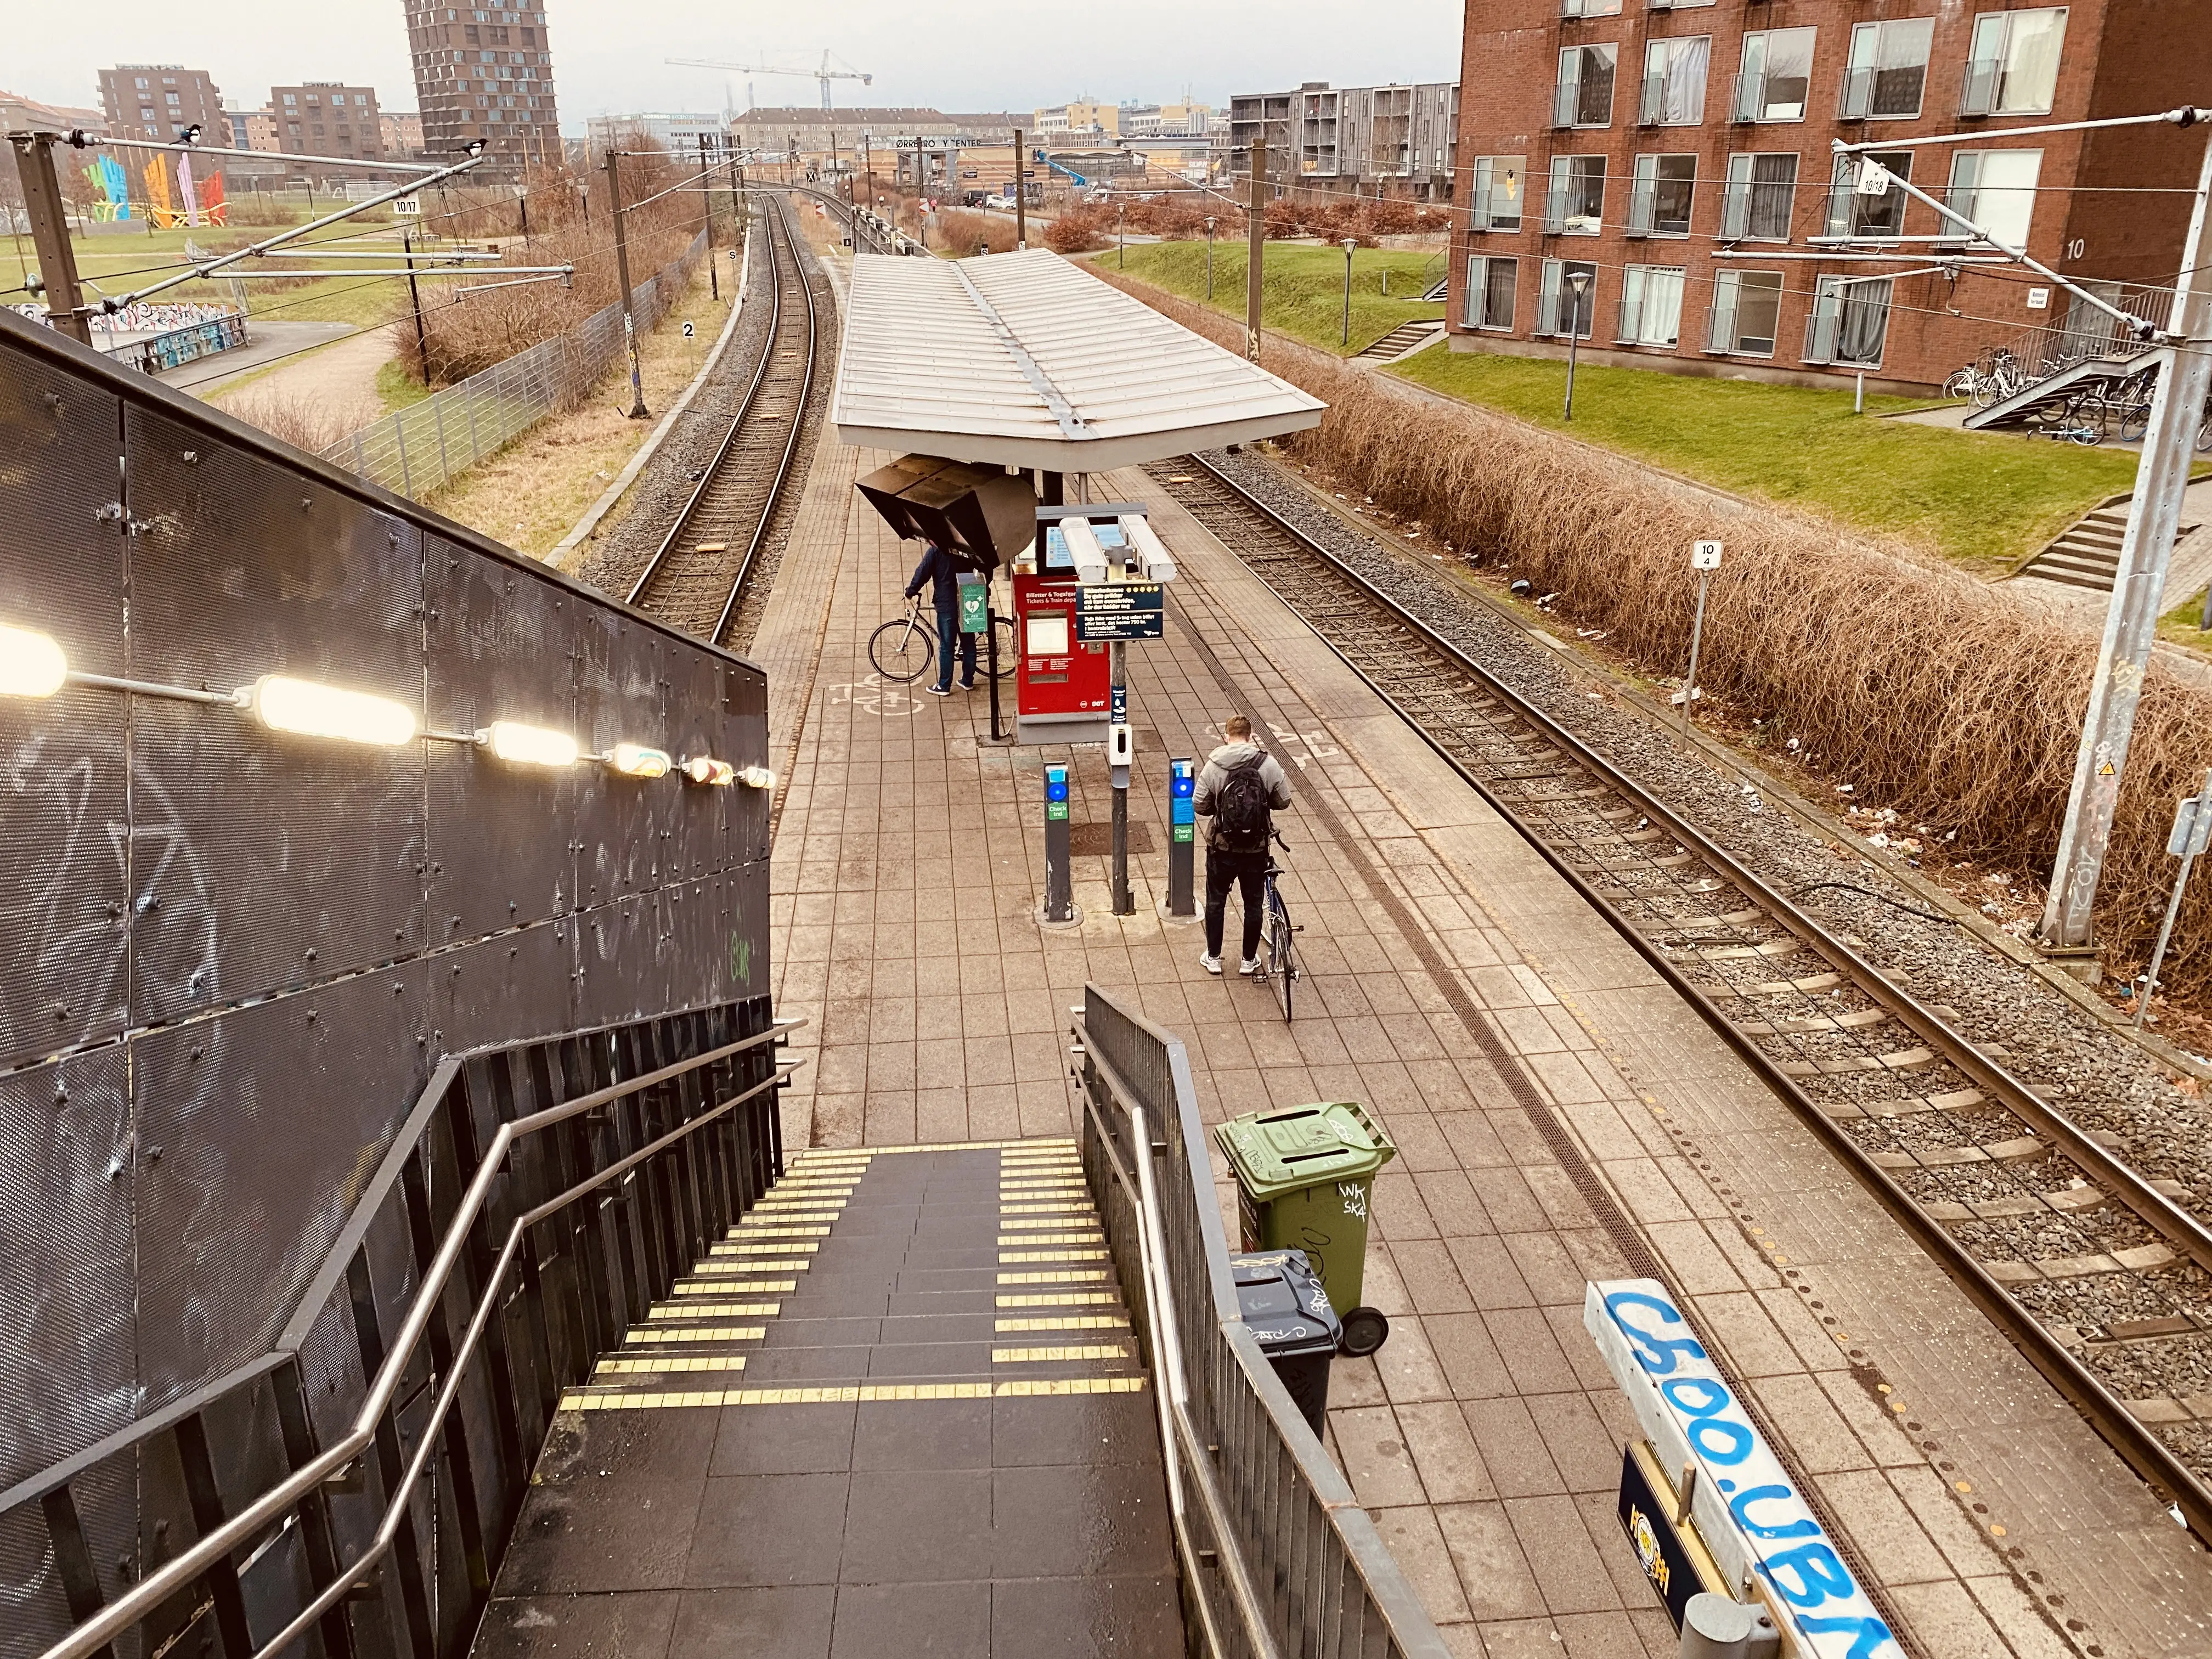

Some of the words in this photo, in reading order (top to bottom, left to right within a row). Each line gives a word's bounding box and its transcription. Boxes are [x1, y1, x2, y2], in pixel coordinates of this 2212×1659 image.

[1865, 179, 1883, 192] 10/18
[397, 201, 416, 212] 10/17
[729, 251, 736, 259] S
[2068, 239, 2085, 259] 10
[684, 324, 693, 337] 2
[1702, 545, 1714, 555] 10
